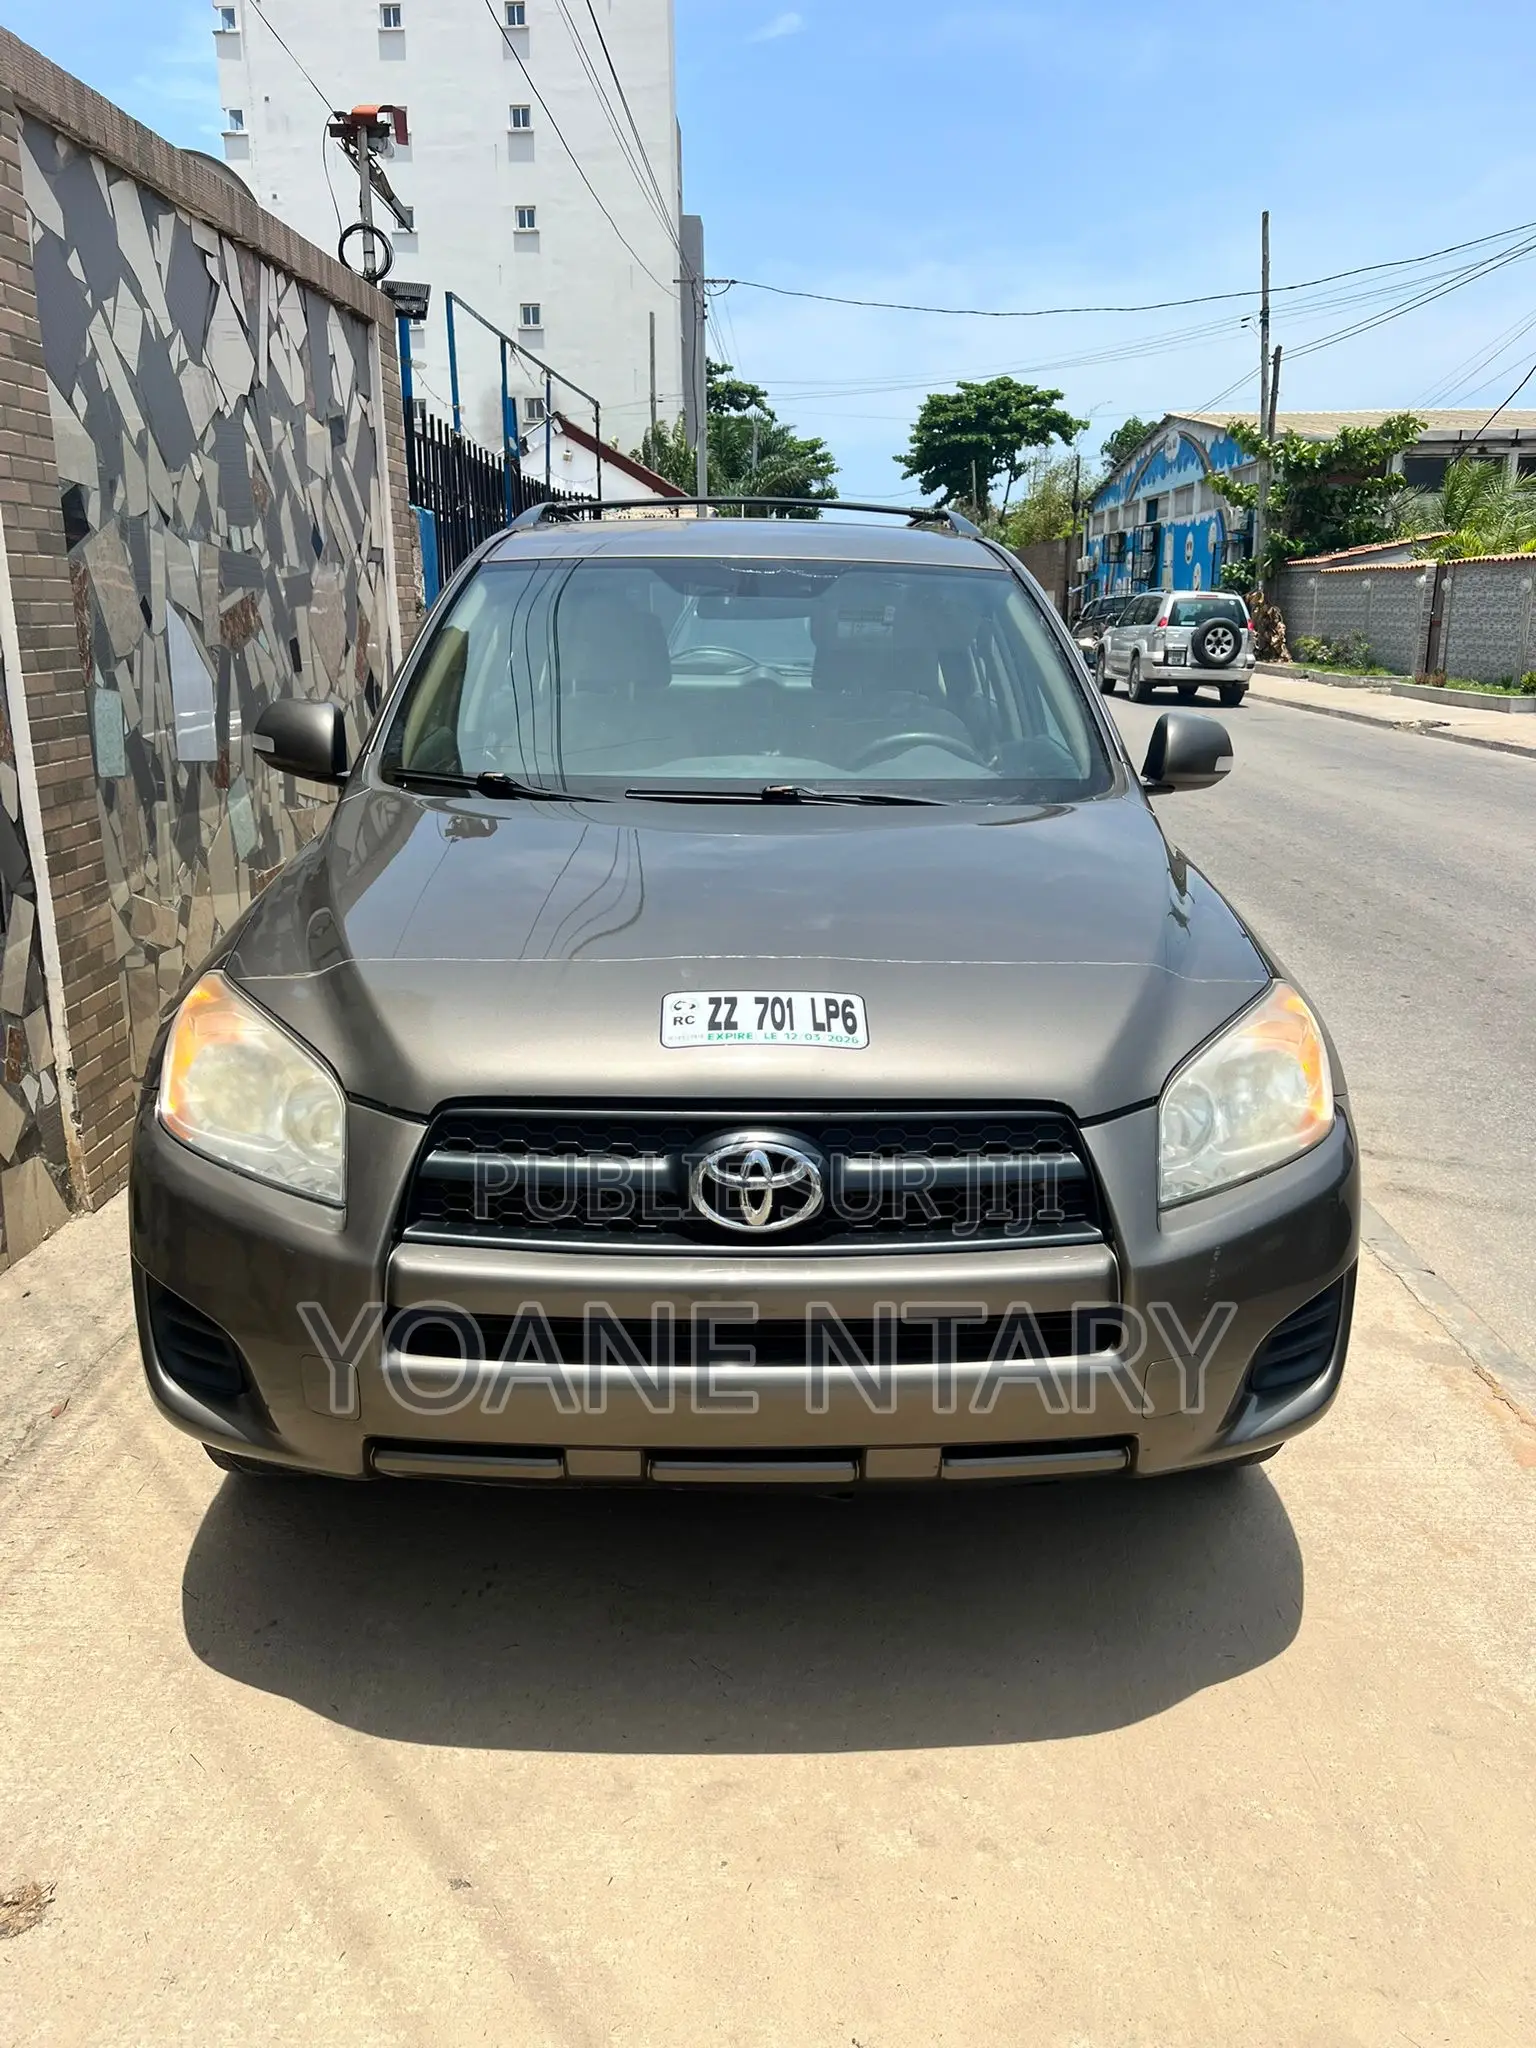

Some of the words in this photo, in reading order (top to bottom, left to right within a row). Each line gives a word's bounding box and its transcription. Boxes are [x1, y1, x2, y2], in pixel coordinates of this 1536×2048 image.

[673, 1015, 695, 1026] RC
[707, 997, 738, 1031] ZZ
[754, 996, 795, 1031] 701
[811, 997, 858, 1035] LP6
[707, 1032, 753, 1041] EXPIRE
[764, 1032, 777, 1040] LE
